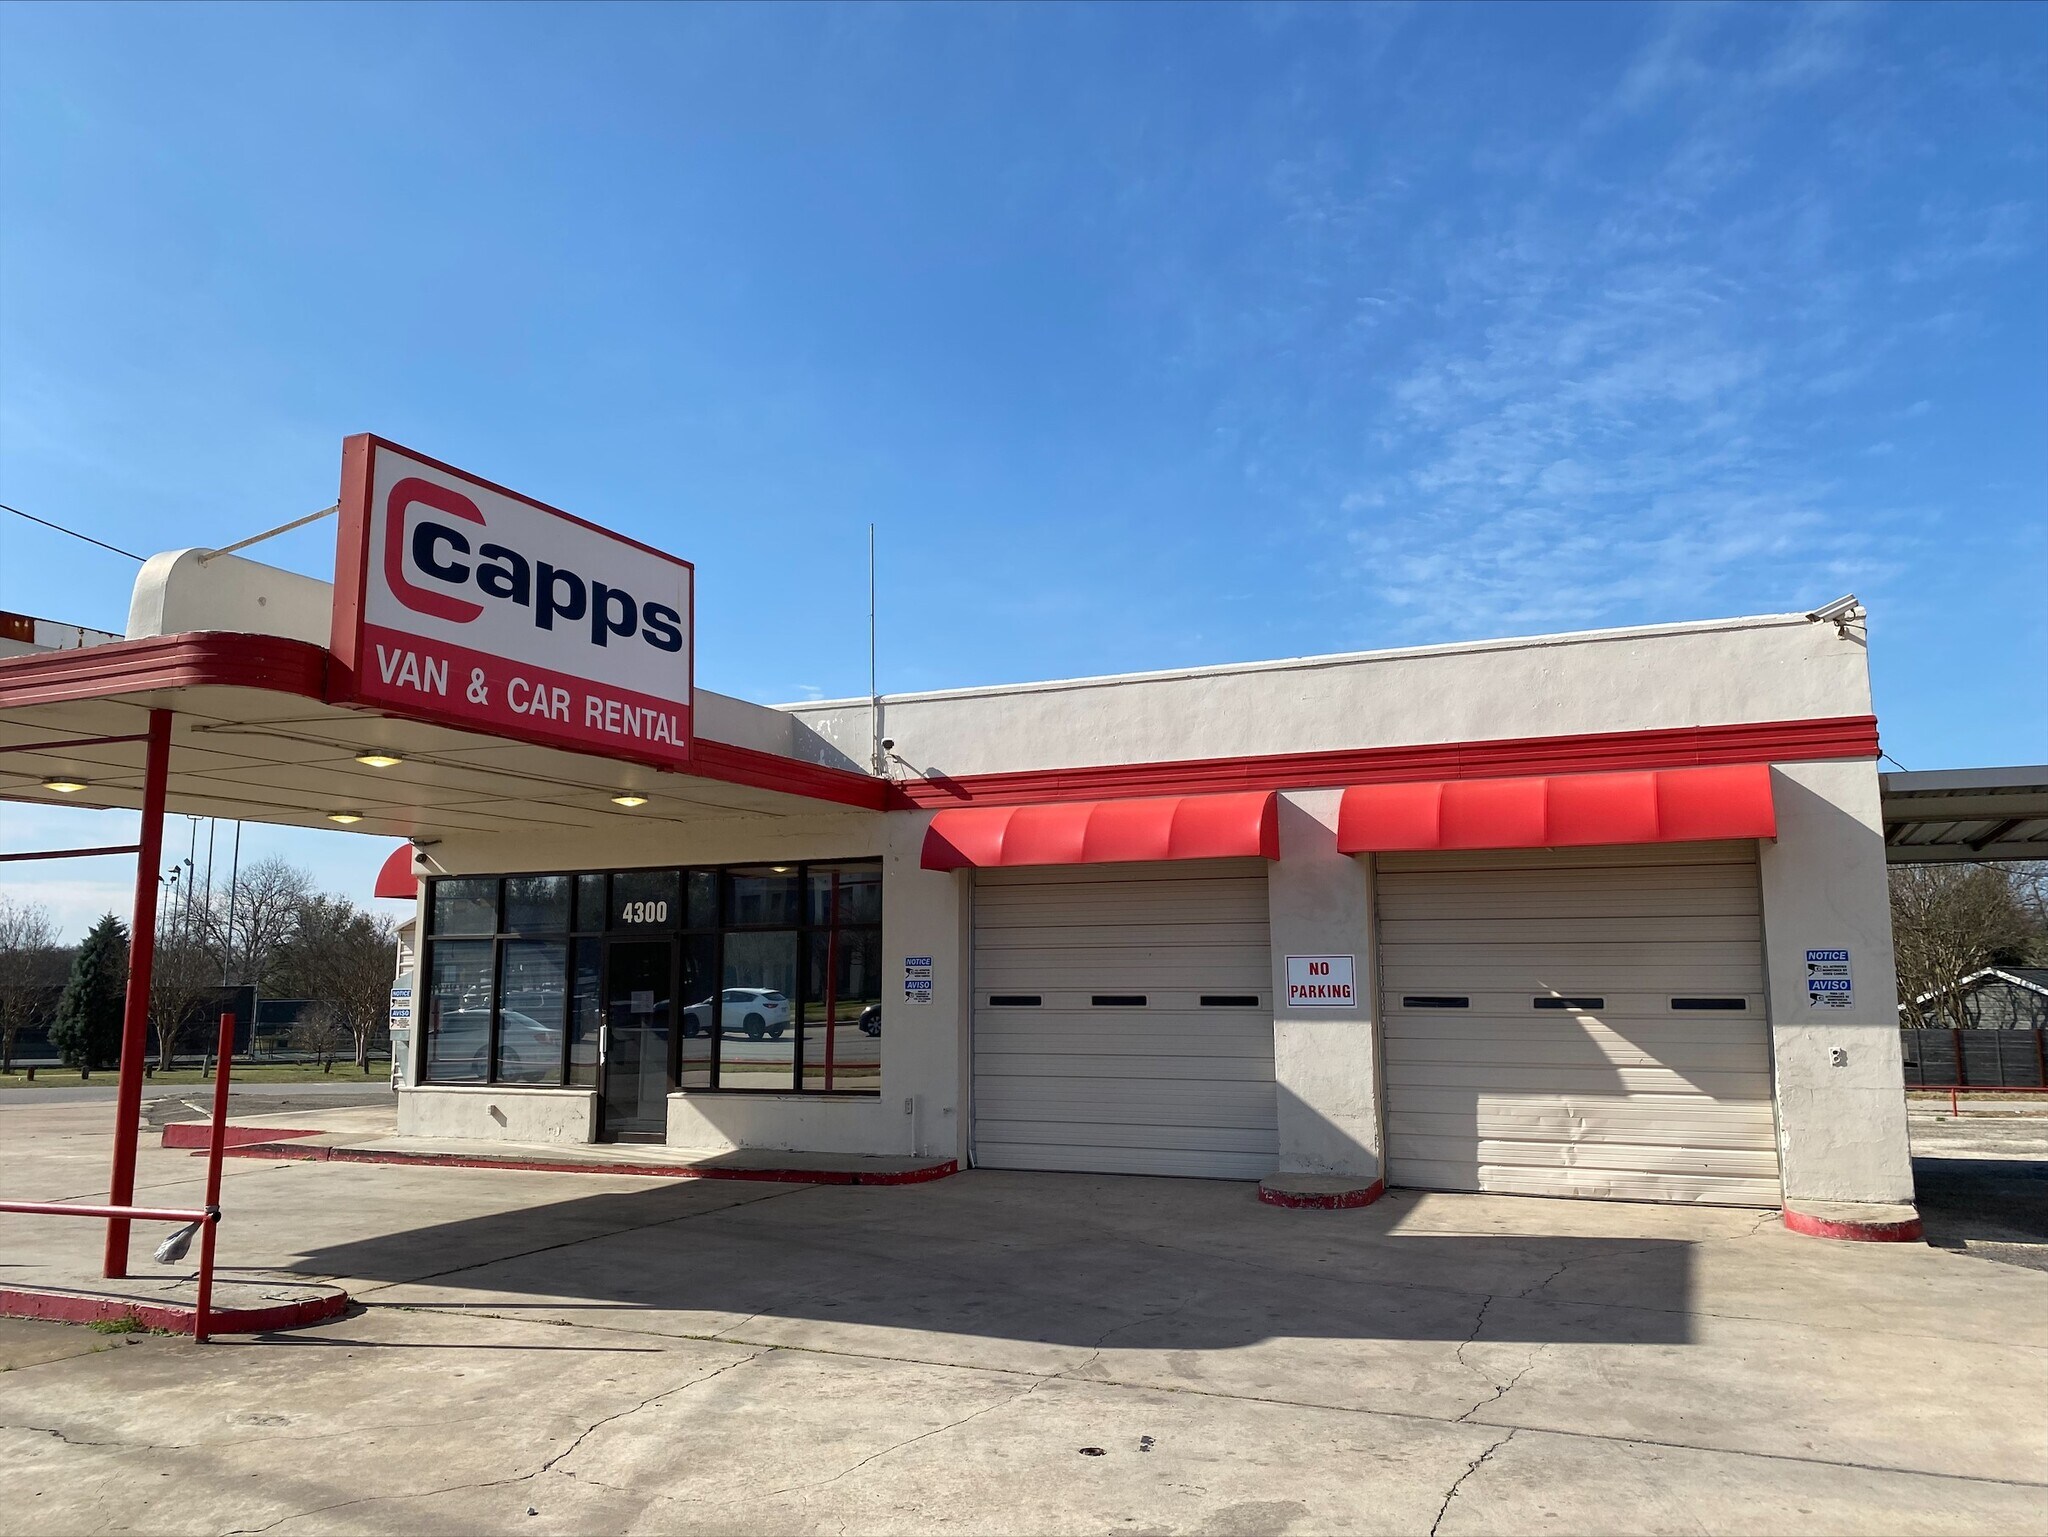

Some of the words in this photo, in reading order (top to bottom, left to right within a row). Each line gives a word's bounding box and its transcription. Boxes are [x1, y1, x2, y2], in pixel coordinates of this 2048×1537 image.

[375, 644, 449, 696] VAN
[466, 667, 489, 706] &
[507, 677, 571, 723] CAR
[585, 695, 685, 747] RENTAL
[622, 901, 667, 923] 4300
[1808, 951, 1847, 960] NOTICE
[1309, 962, 1329, 975] NO
[906, 981, 930, 989] AVISO
[1290, 984, 1351, 998] PARKING
[1812, 980, 1848, 990] AVISO
